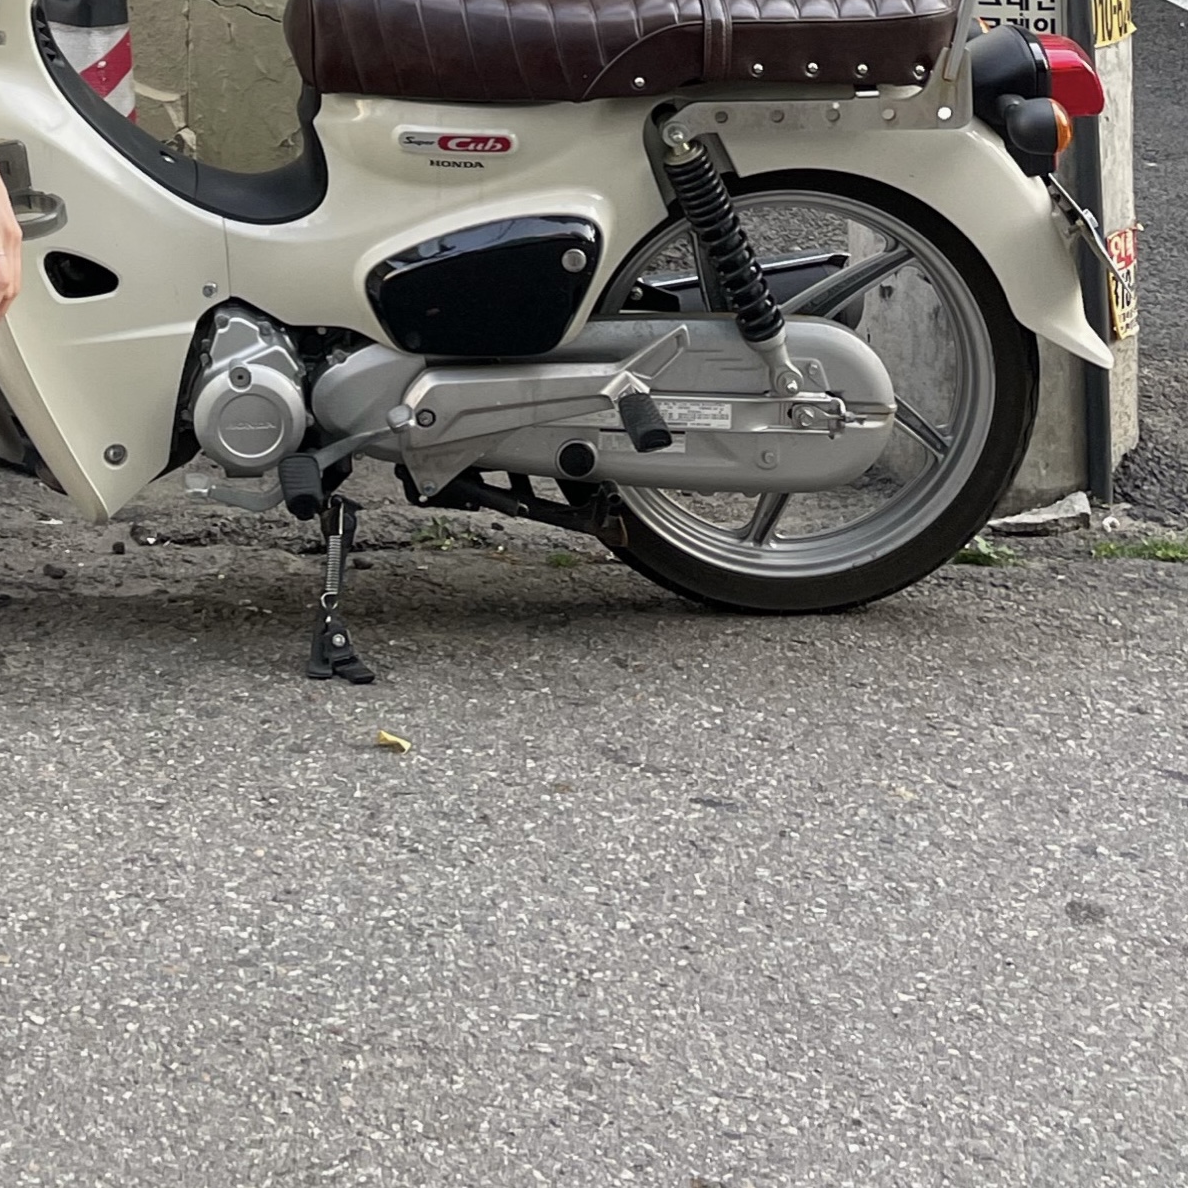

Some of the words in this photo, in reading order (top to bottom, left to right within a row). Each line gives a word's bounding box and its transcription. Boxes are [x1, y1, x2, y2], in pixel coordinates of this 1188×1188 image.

[403, 136, 436, 147] Super
[447, 137, 503, 151] Cub
[429, 159, 485, 169] HONDA
